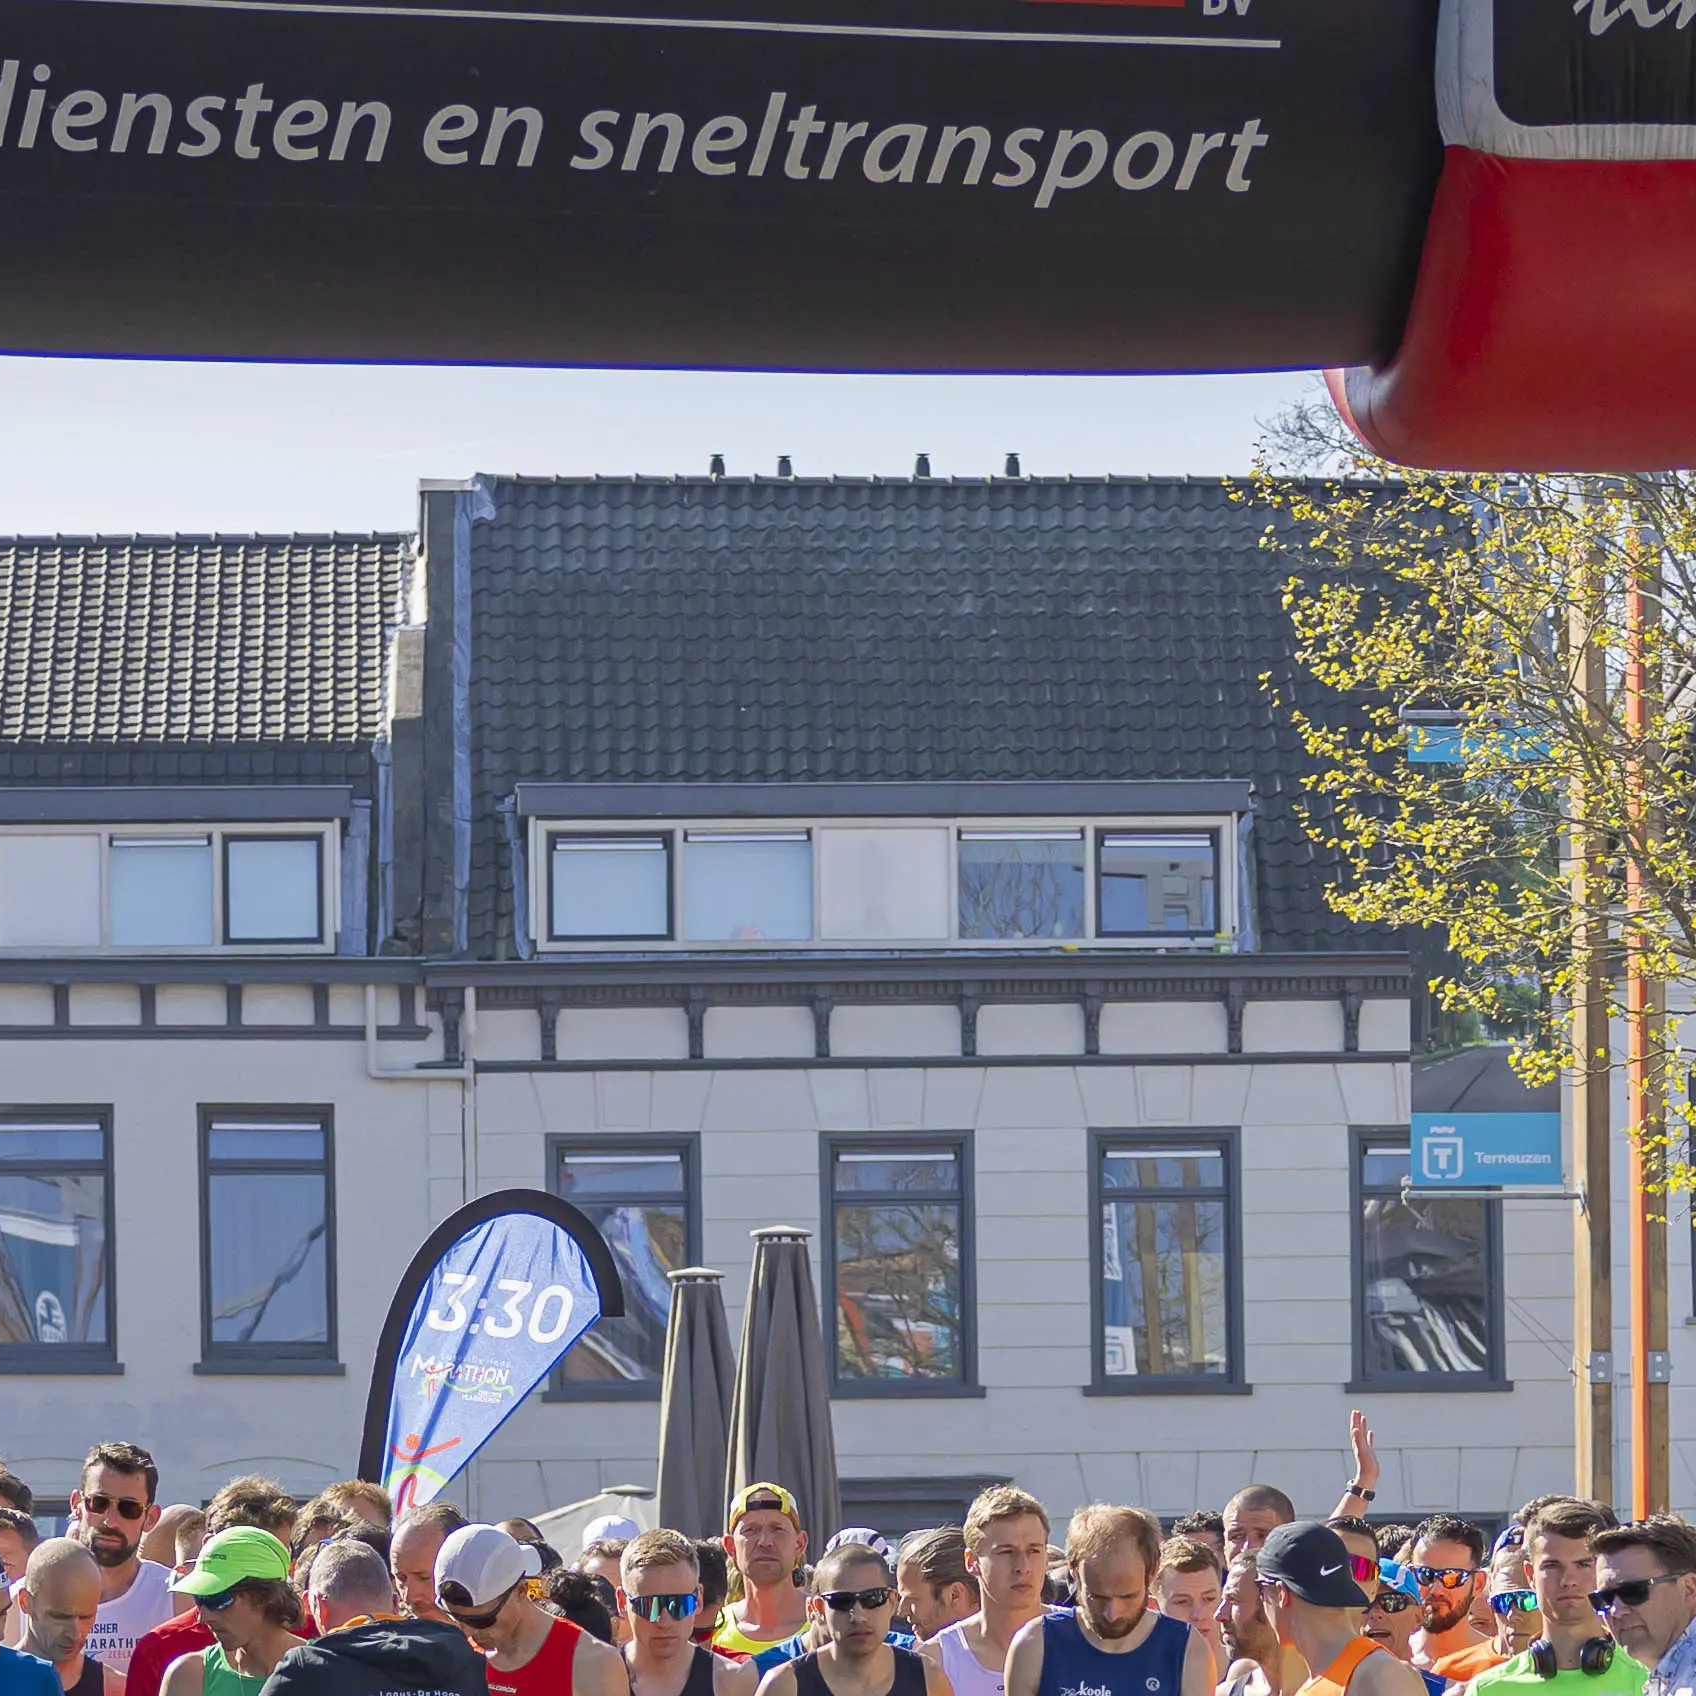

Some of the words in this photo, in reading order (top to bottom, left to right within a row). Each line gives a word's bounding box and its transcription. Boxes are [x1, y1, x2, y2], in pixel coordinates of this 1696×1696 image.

[422, 107, 541, 168] en
[568, 88, 1270, 207] sneltransport
[1474, 1151, 1552, 1165] Terneuzen
[427, 1273, 574, 1344] 3:30
[410, 1353, 510, 1385] MARATHON
